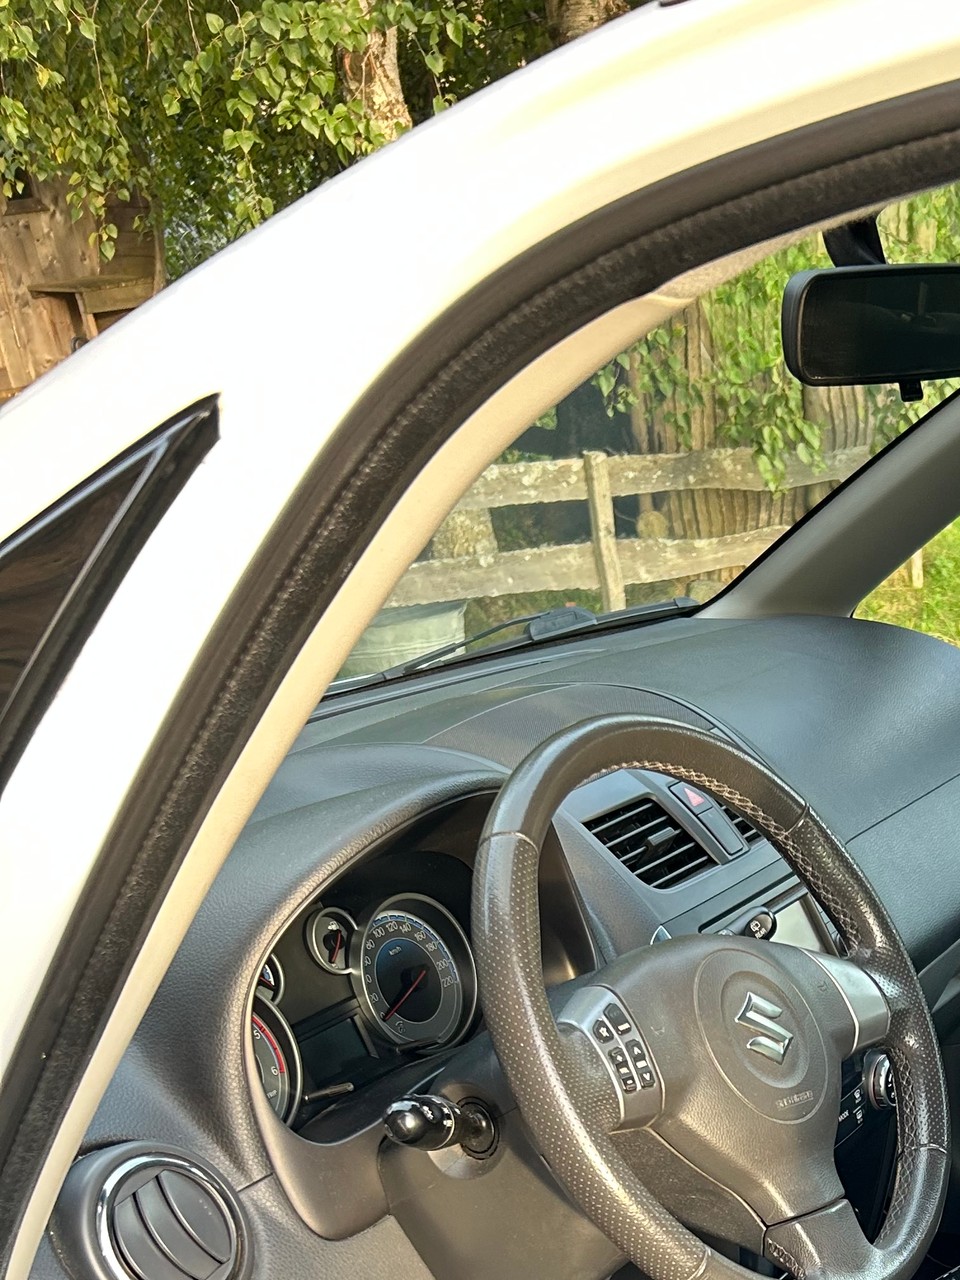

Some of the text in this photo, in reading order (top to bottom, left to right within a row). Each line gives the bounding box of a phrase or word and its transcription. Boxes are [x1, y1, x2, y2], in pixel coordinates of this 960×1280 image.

[373, 927, 385, 938] 100
[386, 921, 398, 933] 120
[400, 923, 412, 933] 140
[414, 930, 426, 941] 160
[426, 941, 438, 952] 180
[437, 959, 448, 970] 200
[442, 976, 454, 988] 220
[253, 1029, 261, 1040] 5
[270, 1065, 279, 1076] 6
